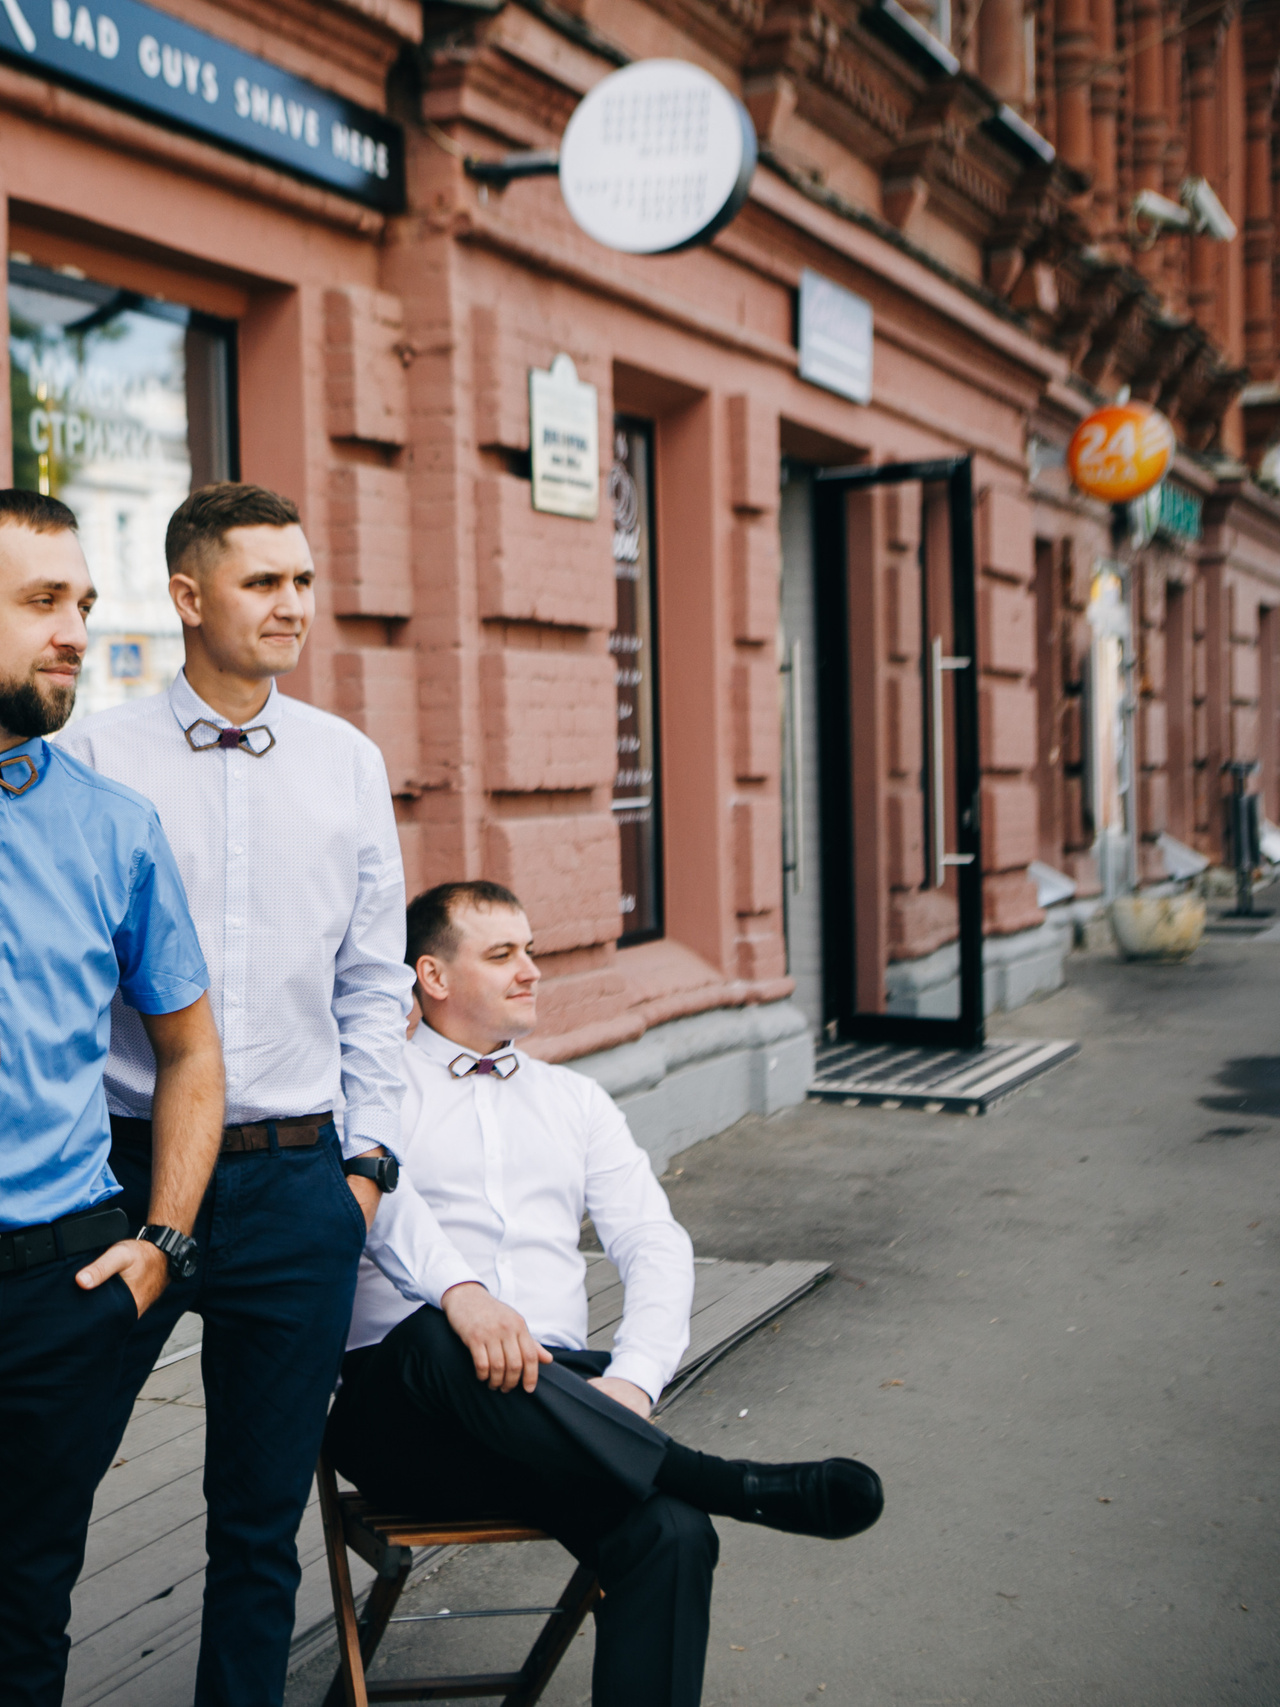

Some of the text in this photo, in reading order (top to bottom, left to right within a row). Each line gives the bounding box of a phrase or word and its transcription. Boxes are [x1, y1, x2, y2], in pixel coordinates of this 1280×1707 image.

[53, 0, 389, 179] BAD GUYS SHAVE HERE
[1080, 422, 1136, 464] 24
